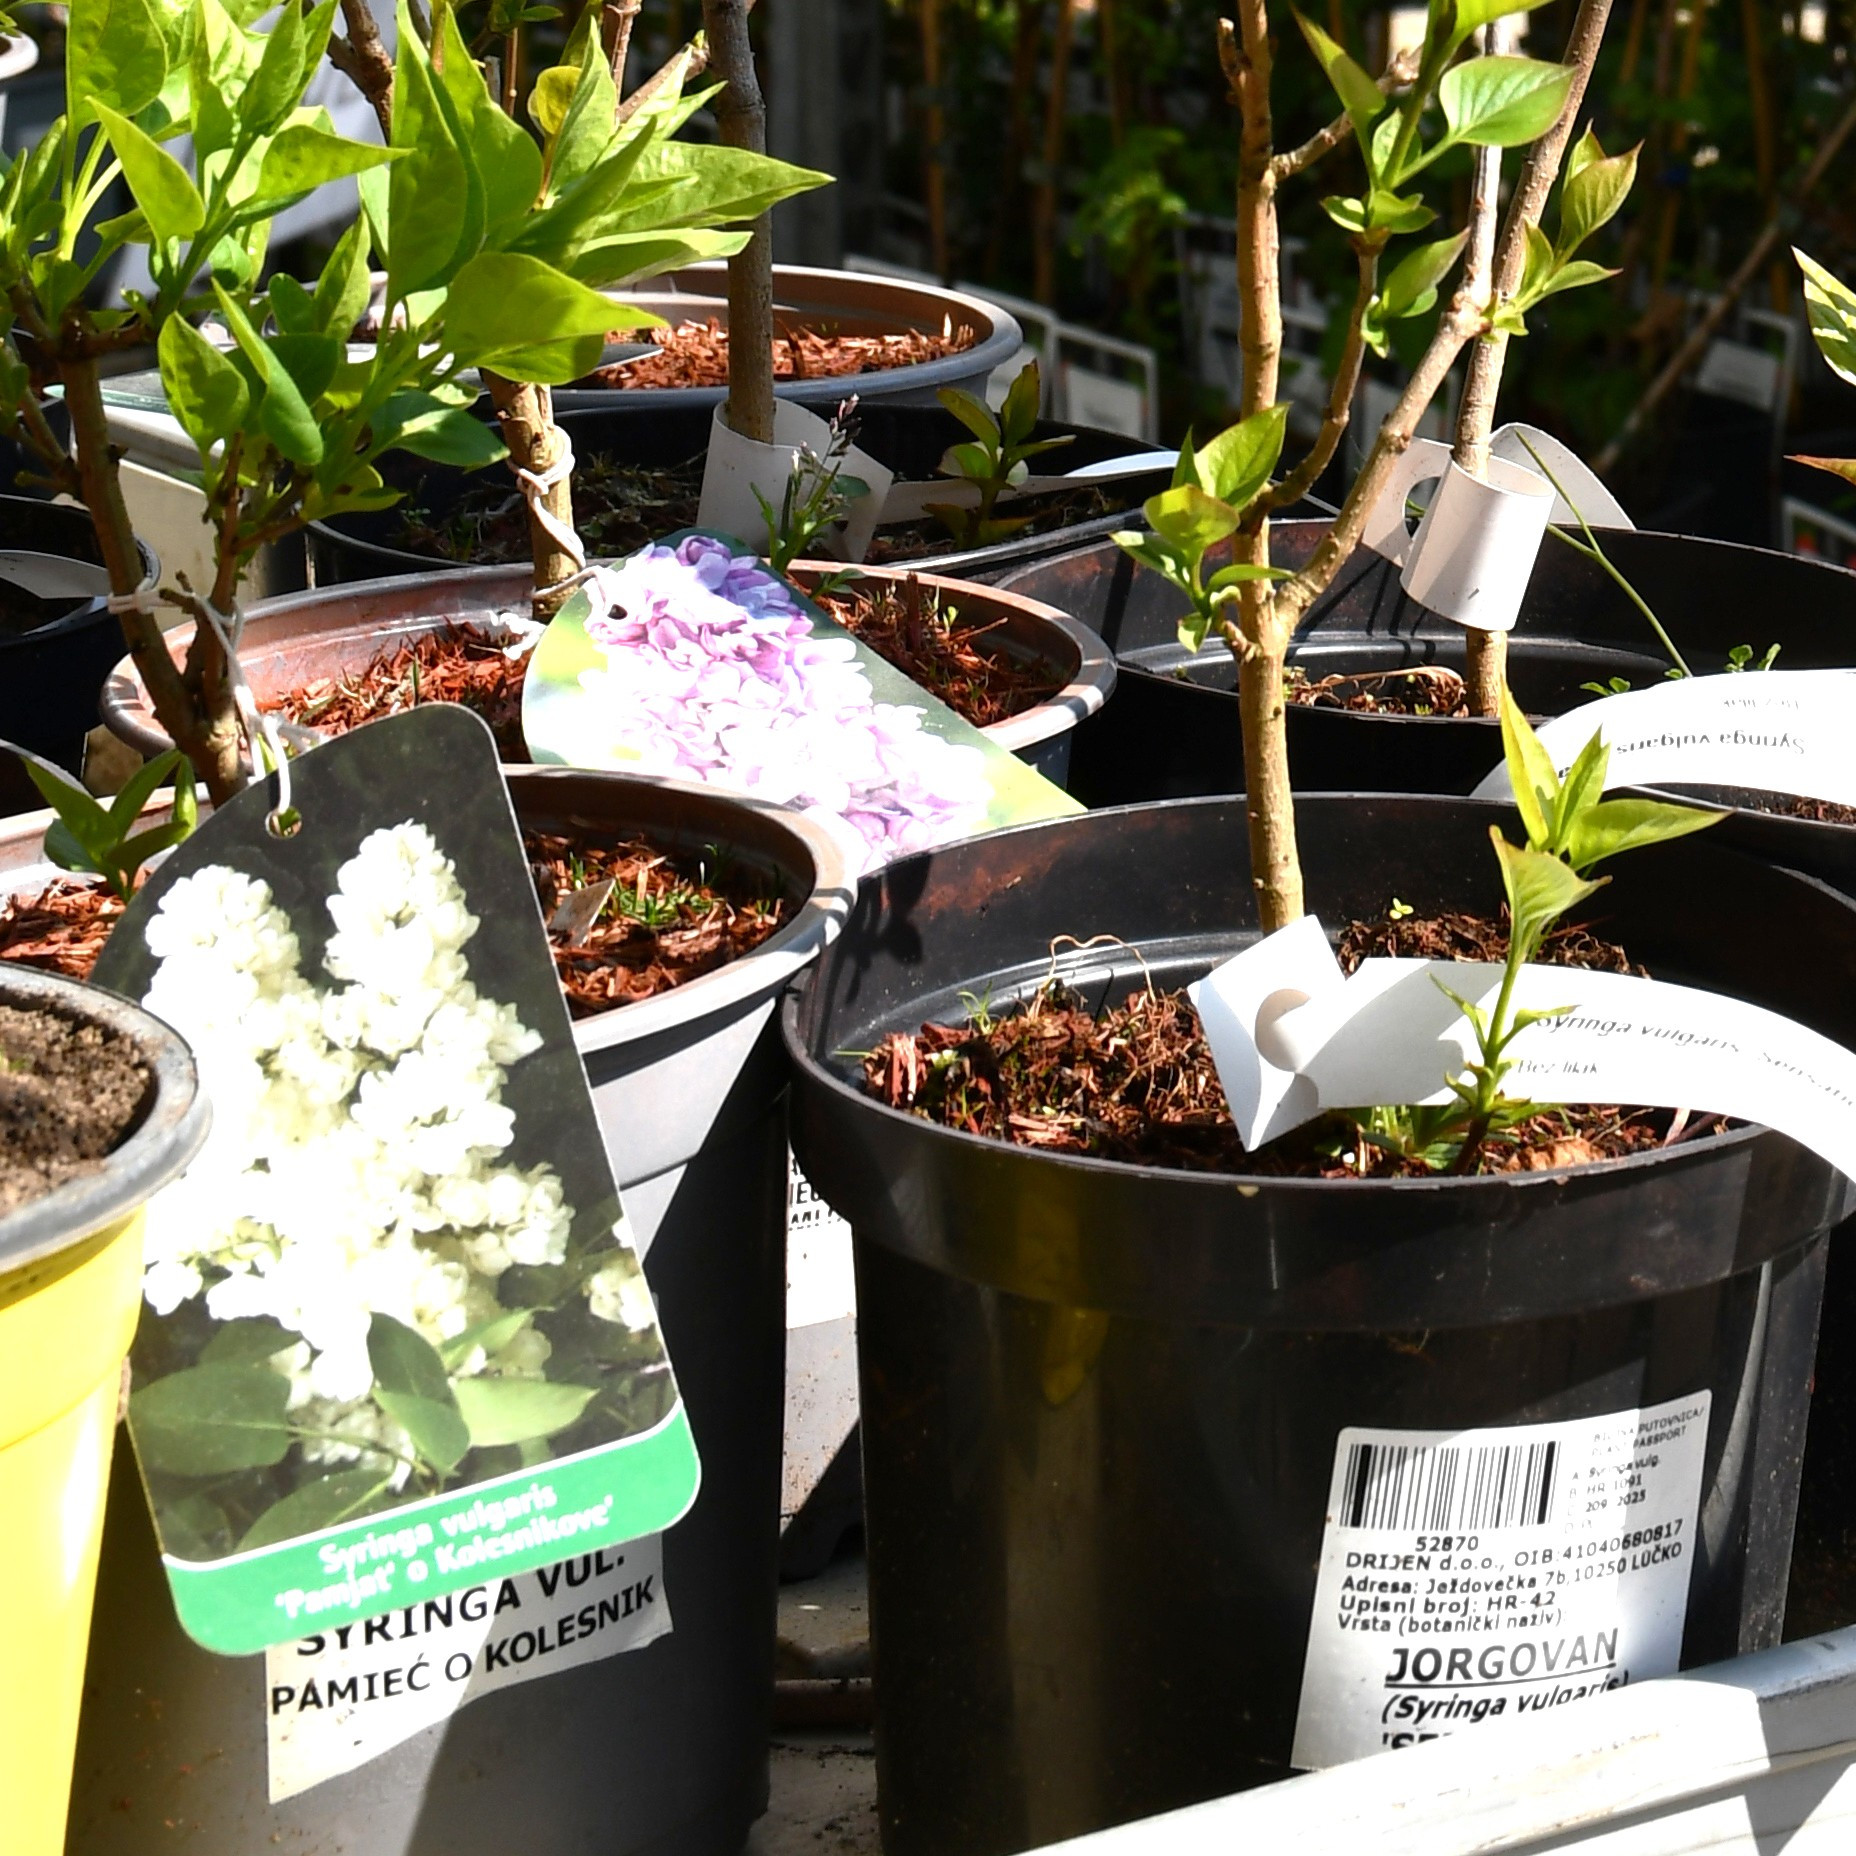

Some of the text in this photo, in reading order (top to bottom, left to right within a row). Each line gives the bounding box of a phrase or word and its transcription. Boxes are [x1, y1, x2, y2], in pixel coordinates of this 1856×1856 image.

[319, 1483, 558, 1575] Syringa vulgaris
[1415, 1536, 1479, 1552] 52870
[407, 1560, 428, 1582] o
[1346, 1552, 1431, 1571] DRIJEN
[1439, 1555, 1504, 1572] d.o.o.,
[1341, 1575, 1419, 1594] Adresa:
[1424, 1597, 1478, 1617] broj:
[1487, 1591, 1555, 1612] HR-42
[1338, 1613, 1391, 1632] Vrsta
[272, 1574, 654, 1715] PAMIEĆ O KOLESNIK
[1384, 1628, 1619, 1683] JORGOVAN
[1381, 1693, 1507, 1725] (Syringa
